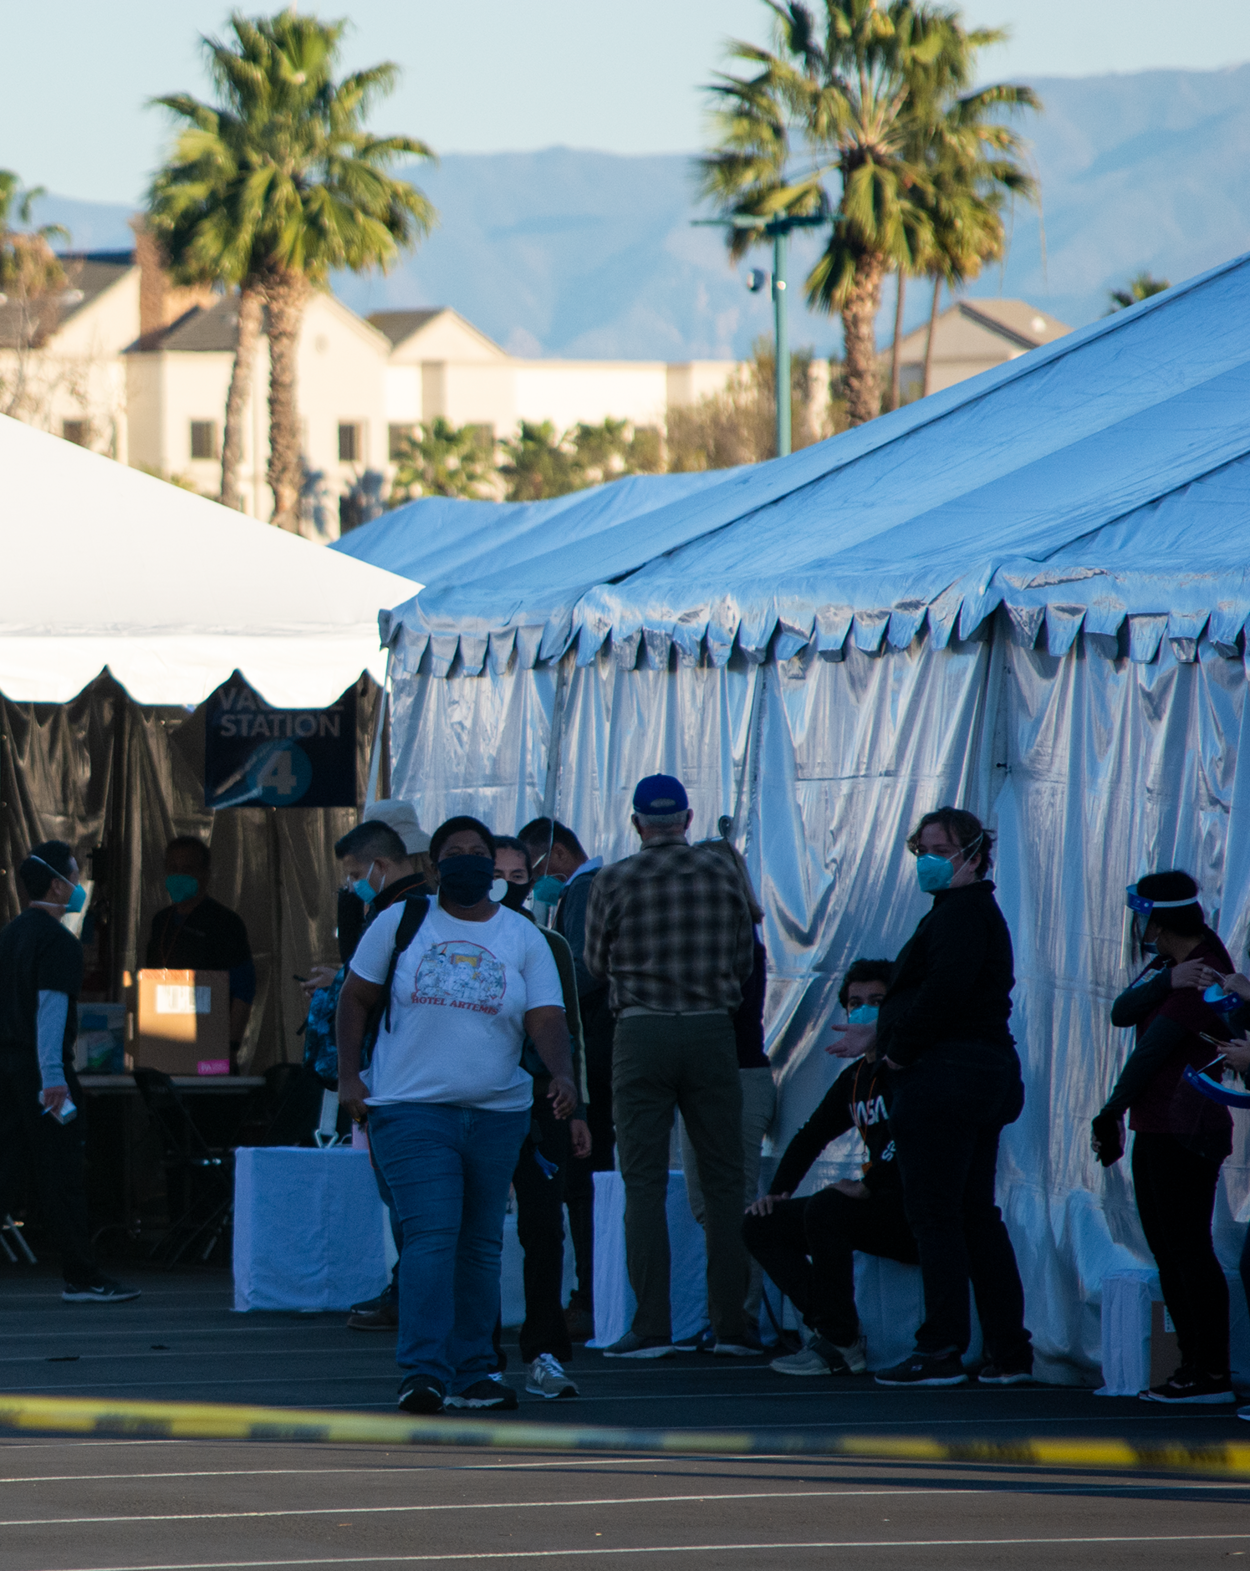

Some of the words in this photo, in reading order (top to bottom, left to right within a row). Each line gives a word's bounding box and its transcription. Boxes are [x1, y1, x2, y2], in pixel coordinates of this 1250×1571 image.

[220, 714, 341, 738] STATION
[256, 750, 297, 795] 4
[412, 995, 447, 1006] HOTEL
[449, 999, 499, 1016] ARTEMIS
[848, 1094, 890, 1127] NASA
